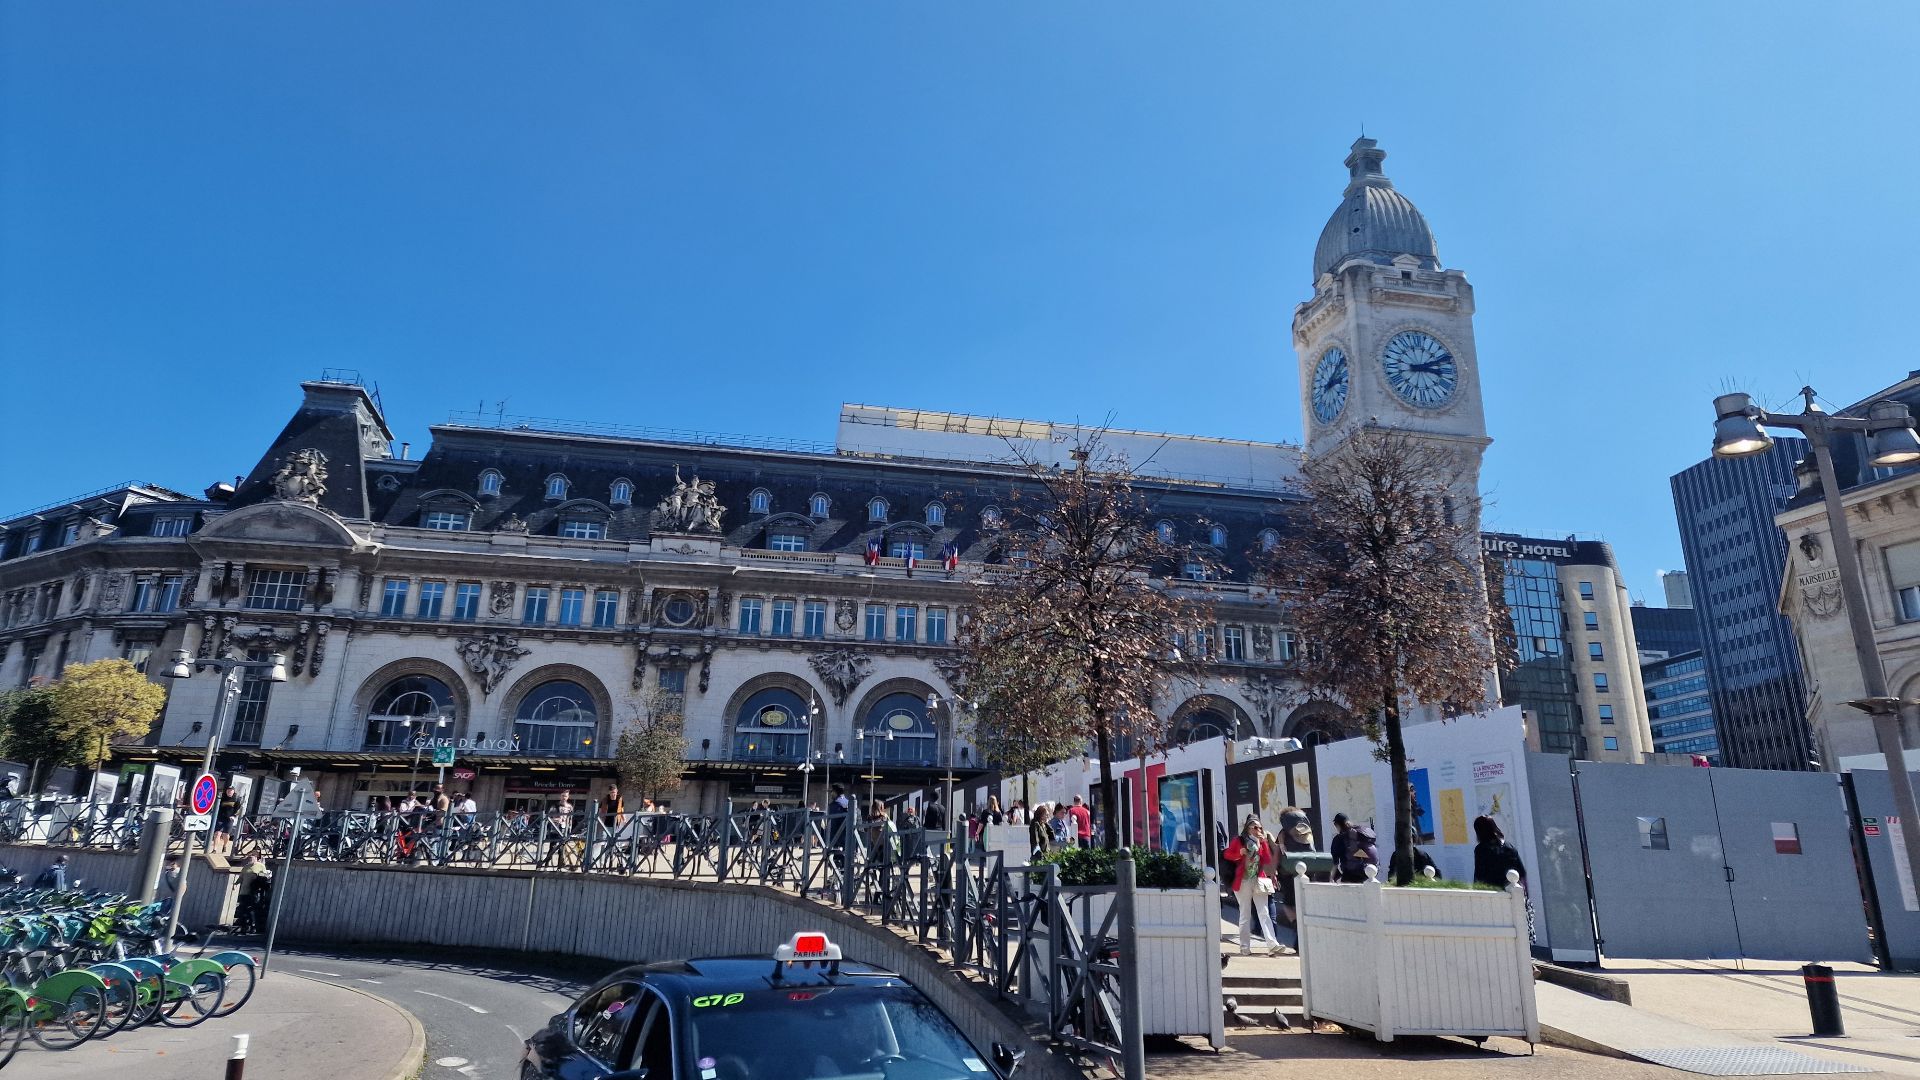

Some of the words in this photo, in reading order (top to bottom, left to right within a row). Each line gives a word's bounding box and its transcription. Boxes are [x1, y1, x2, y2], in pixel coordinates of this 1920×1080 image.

[1799, 570, 1838, 586] MARSEILLE
[414, 737, 452, 748] GARE
[458, 738, 479, 749] DE
[482, 739, 520, 750] LYON
[793, 950, 829, 958] PARISIEN
